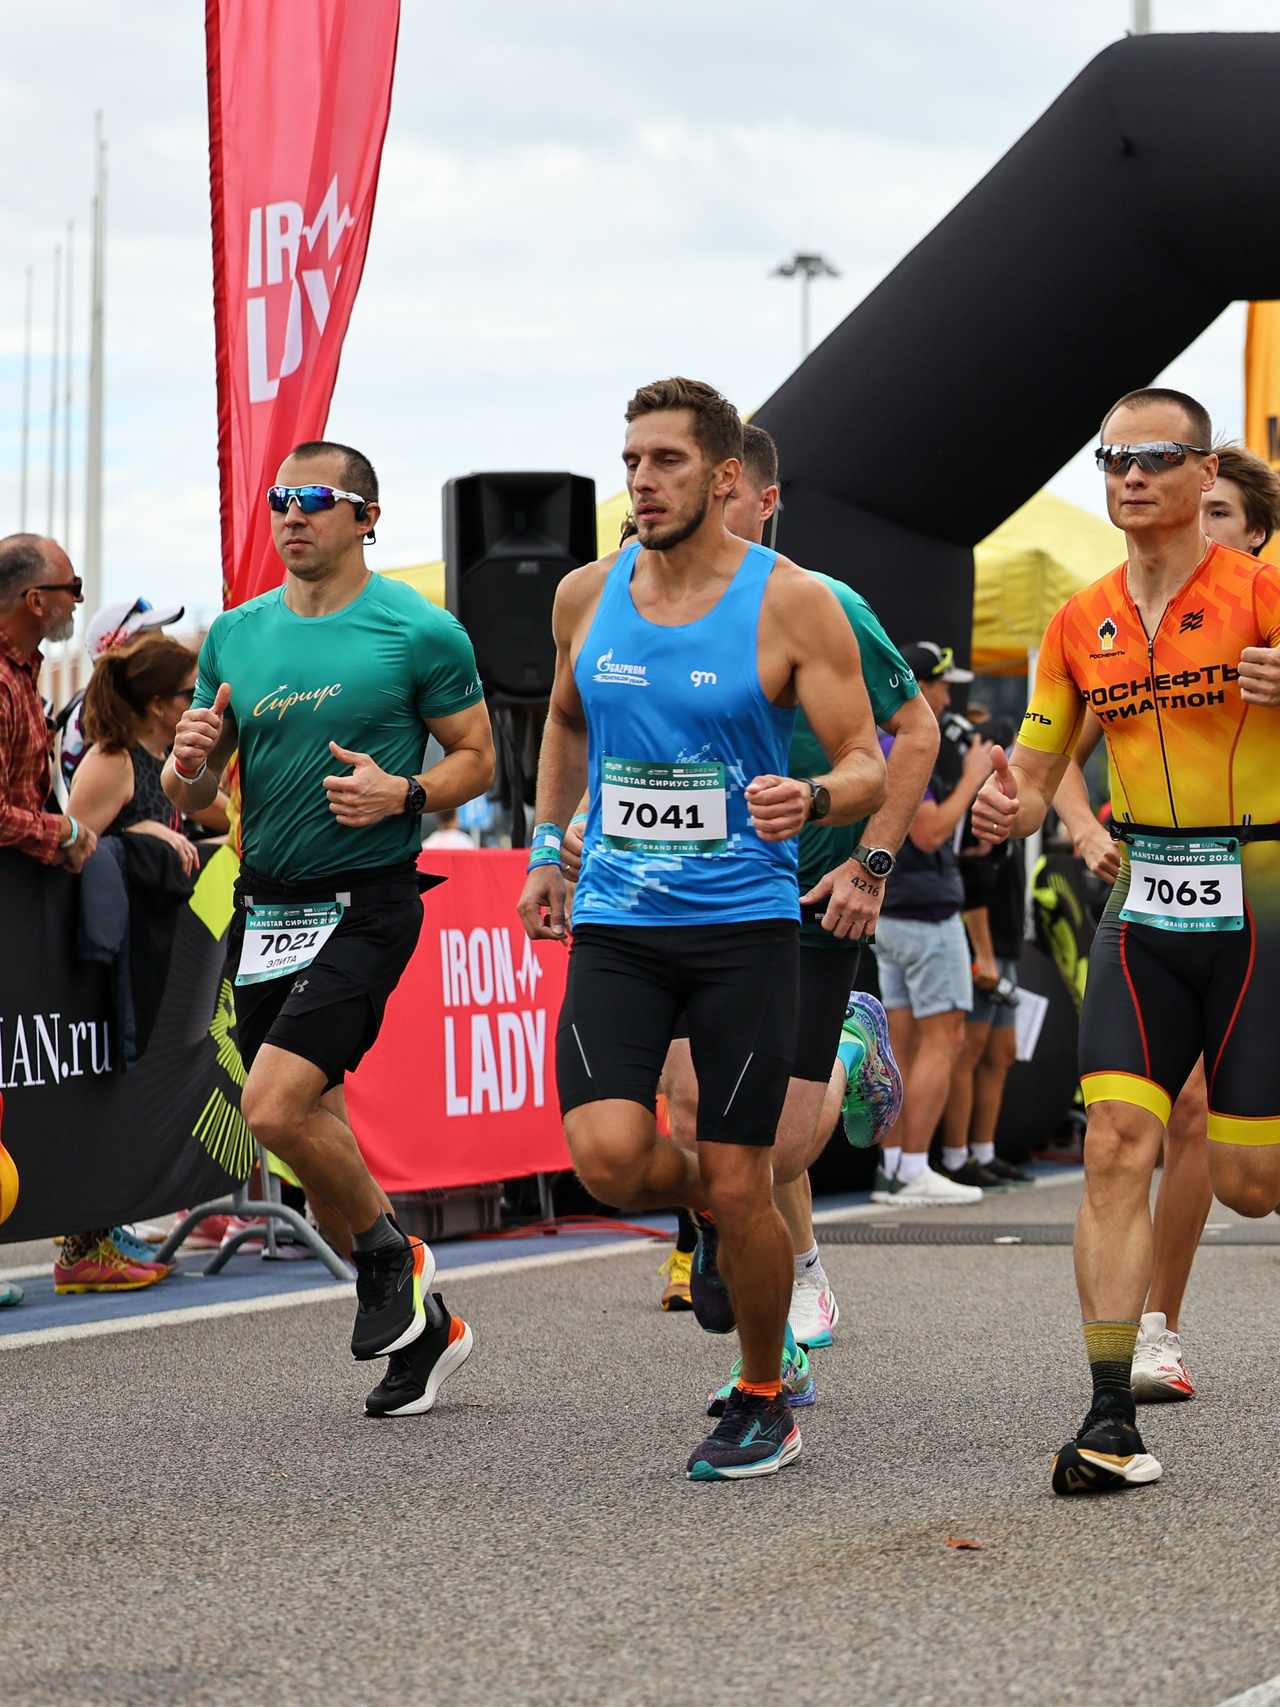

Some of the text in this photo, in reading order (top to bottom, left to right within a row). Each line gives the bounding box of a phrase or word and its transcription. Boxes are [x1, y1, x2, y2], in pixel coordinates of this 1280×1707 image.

[1089, 650, 1126, 659] РОСНЕФТЬ
[609, 663, 647, 676] GAZPROM
[1082, 663, 1239, 706] РОСНЕФТЬ
[253, 682, 343, 720] Сириус
[1096, 689, 1225, 724] ТРИАТЛОН
[605, 773, 719, 787] MANSTAR СИРИУС 2026
[618, 800, 704, 829] 7041
[1131, 850, 1235, 863] MANSTAR СИРИУС 2026
[851, 876, 880, 898] 4216
[1143, 876, 1222, 906] 7063
[285, 918, 318, 927] СИРИУС
[1164, 920, 1188, 928] GRAND
[260, 930, 320, 957] 7021
[266, 955, 298, 969] ЭЛИТА
[440, 926, 517, 1008] IRON
[444, 1008, 547, 1117] LADY
